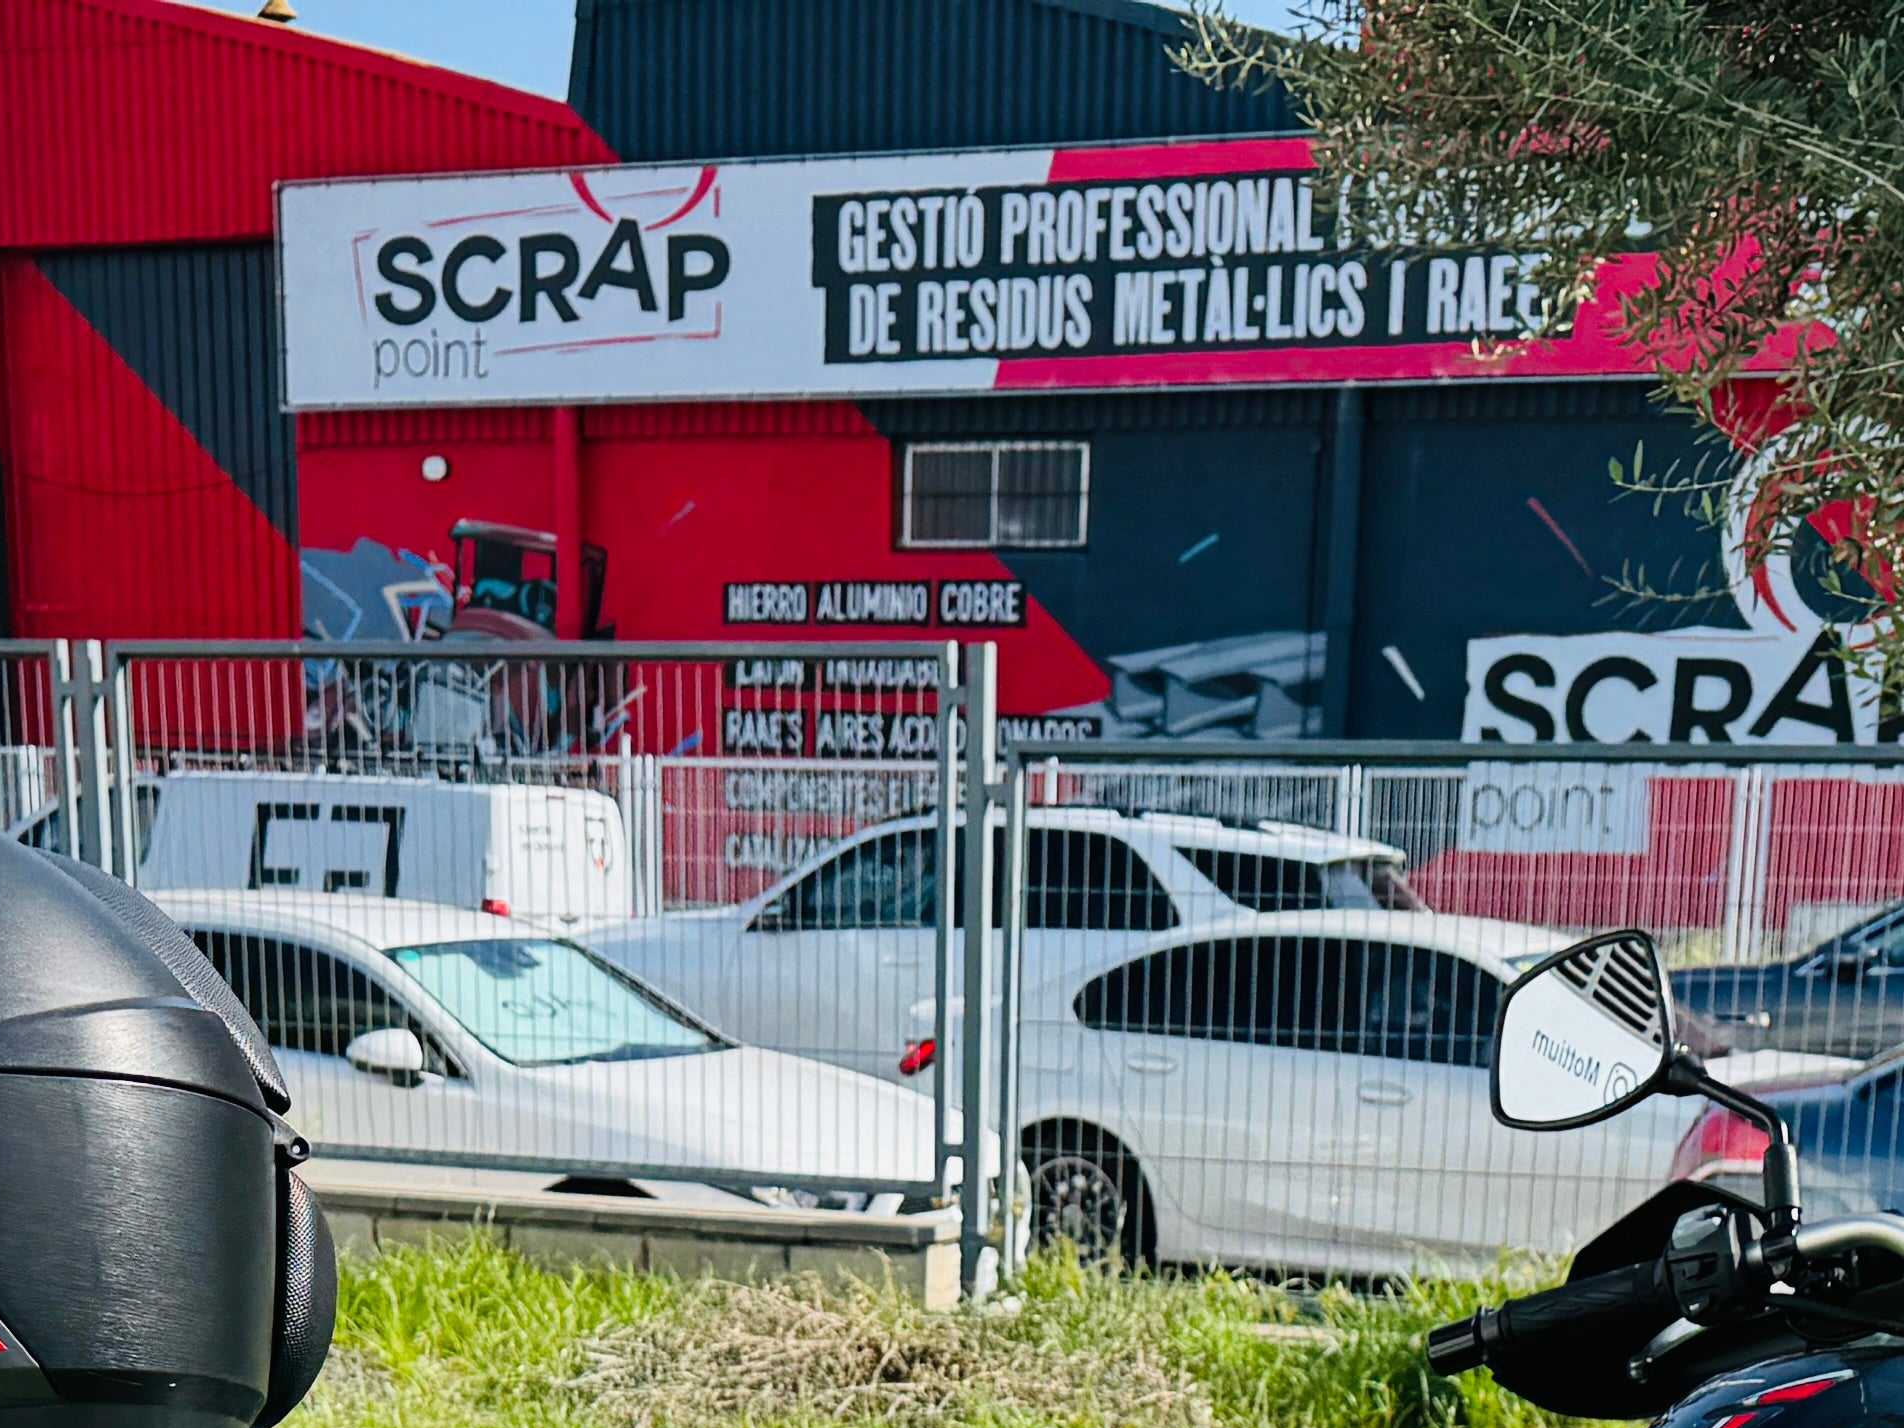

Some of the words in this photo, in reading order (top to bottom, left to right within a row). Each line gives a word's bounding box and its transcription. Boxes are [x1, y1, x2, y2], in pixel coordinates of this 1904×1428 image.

[374, 218, 731, 326] SCRAP
[838, 186, 983, 274] GESTIÓ
[1002, 176, 1324, 268] PROFESSIONAL
[849, 287, 899, 356] DE
[916, 268, 1092, 354] RESIDUS
[1387, 260, 1406, 336] I
[373, 328, 490, 388] point
[727, 583, 808, 624] HIERRO
[816, 583, 929, 624] ALUMINIO
[940, 582, 1023, 625] COBRE
